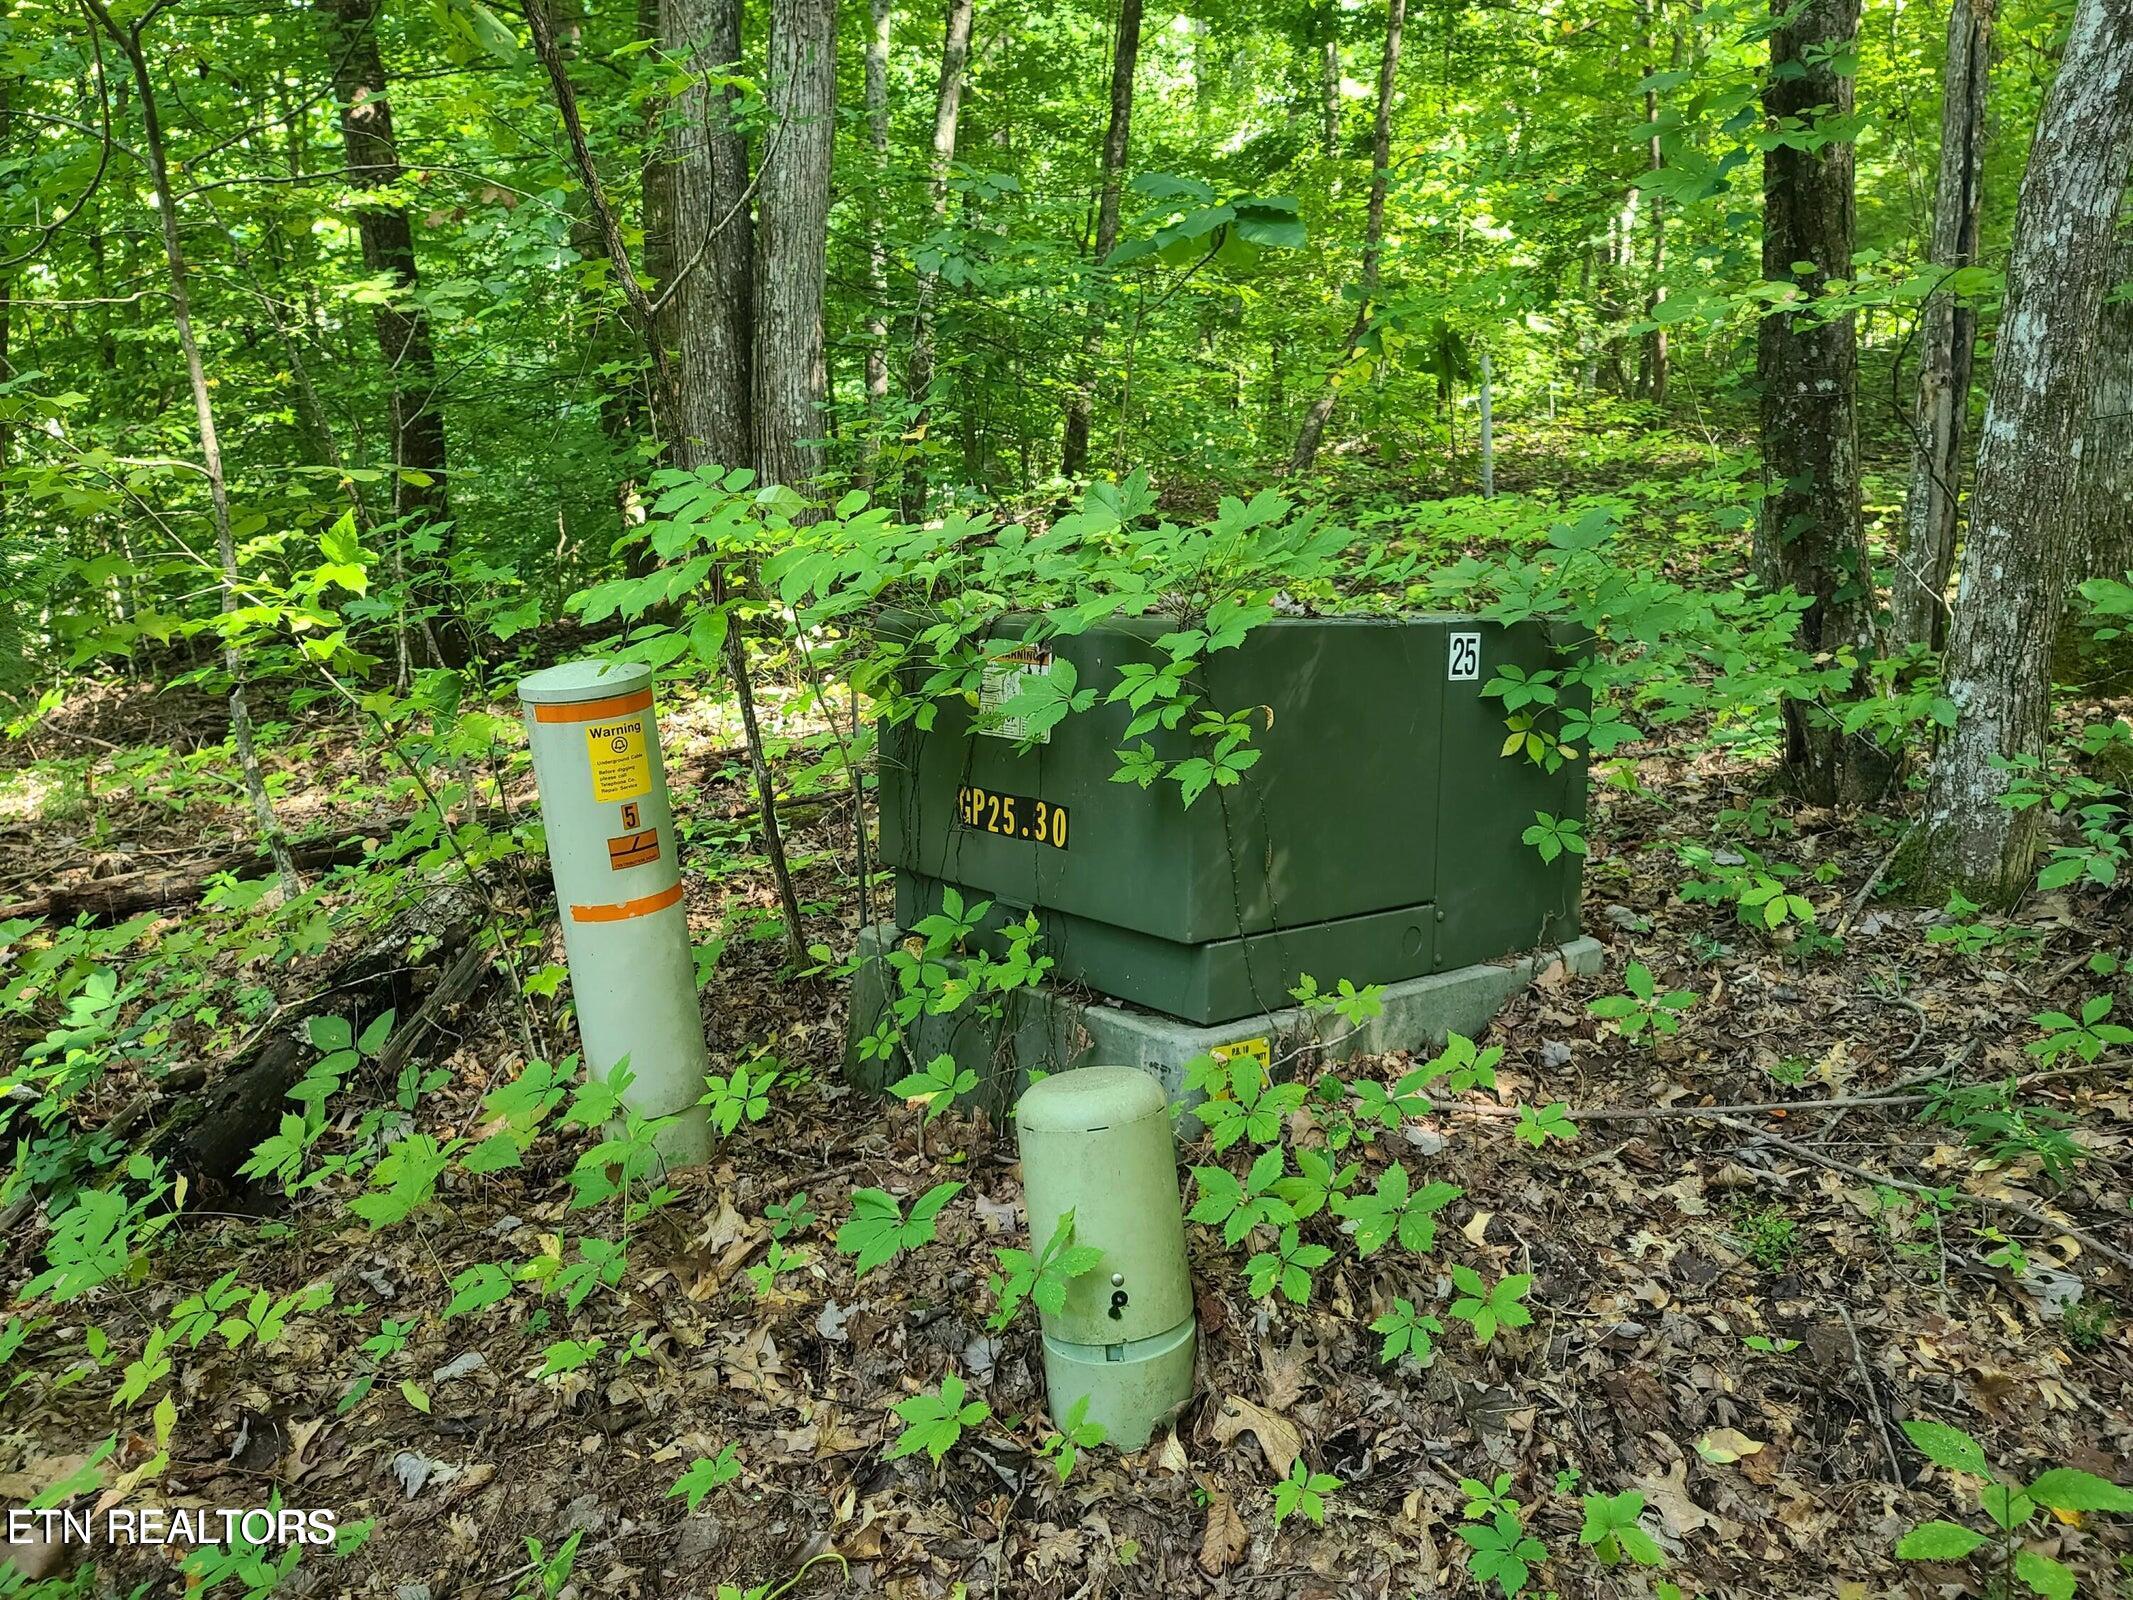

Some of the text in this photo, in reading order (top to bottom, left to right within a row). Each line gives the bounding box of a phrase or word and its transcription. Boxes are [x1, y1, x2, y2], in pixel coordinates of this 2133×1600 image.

[1452, 637, 1476, 675] 25
[589, 722, 641, 739] Warning
[597, 756, 630, 765] Underground
[624, 805, 636, 828] 5
[960, 787, 1067, 848] GP25.30
